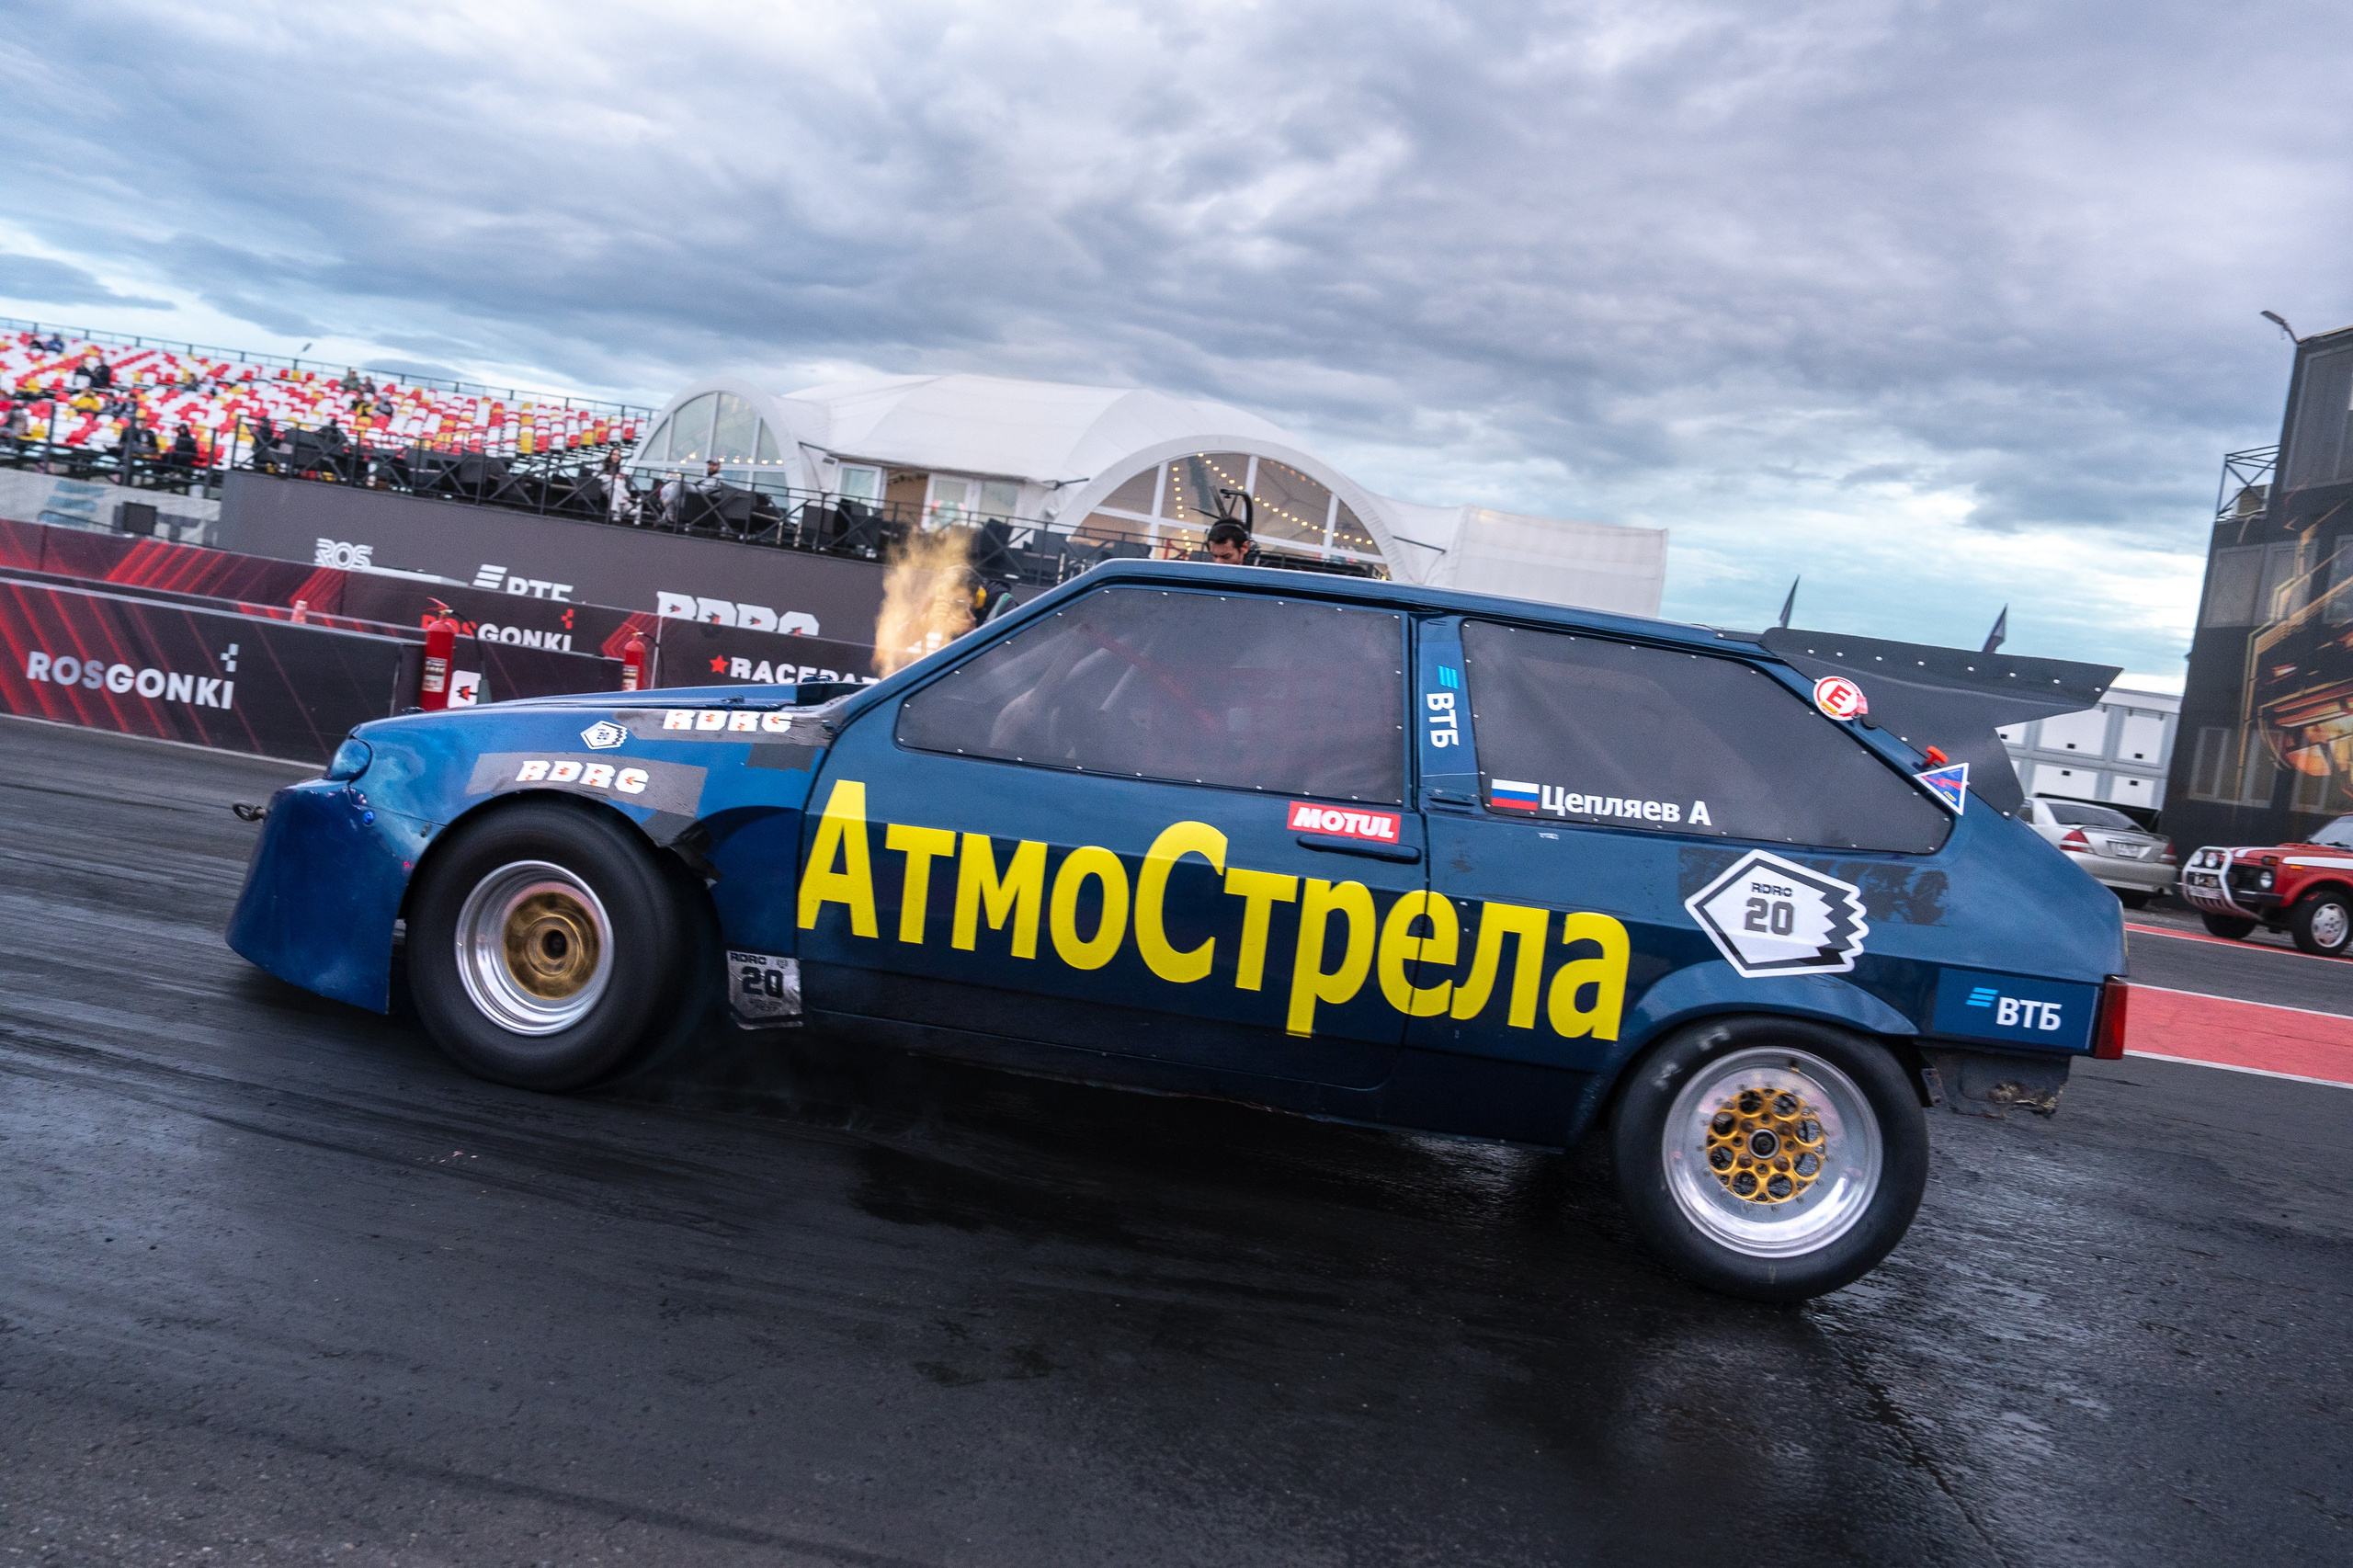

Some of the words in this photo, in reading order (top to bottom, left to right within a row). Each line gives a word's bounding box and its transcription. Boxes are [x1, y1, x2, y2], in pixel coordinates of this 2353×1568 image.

[28, 651, 234, 710] ROSGONKI
[1826, 685, 1852, 710] E
[1427, 692, 1460, 747] ВТБ
[1541, 785, 1680, 823] Цепляев
[1292, 807, 1394, 838] MOTUL
[1751, 882, 1793, 897] RDRC
[798, 779, 1631, 1041] АтмоСтрела
[1745, 897, 1794, 936] 20
[742, 966, 783, 998] 20
[1995, 996, 2063, 1031] ВТБ
